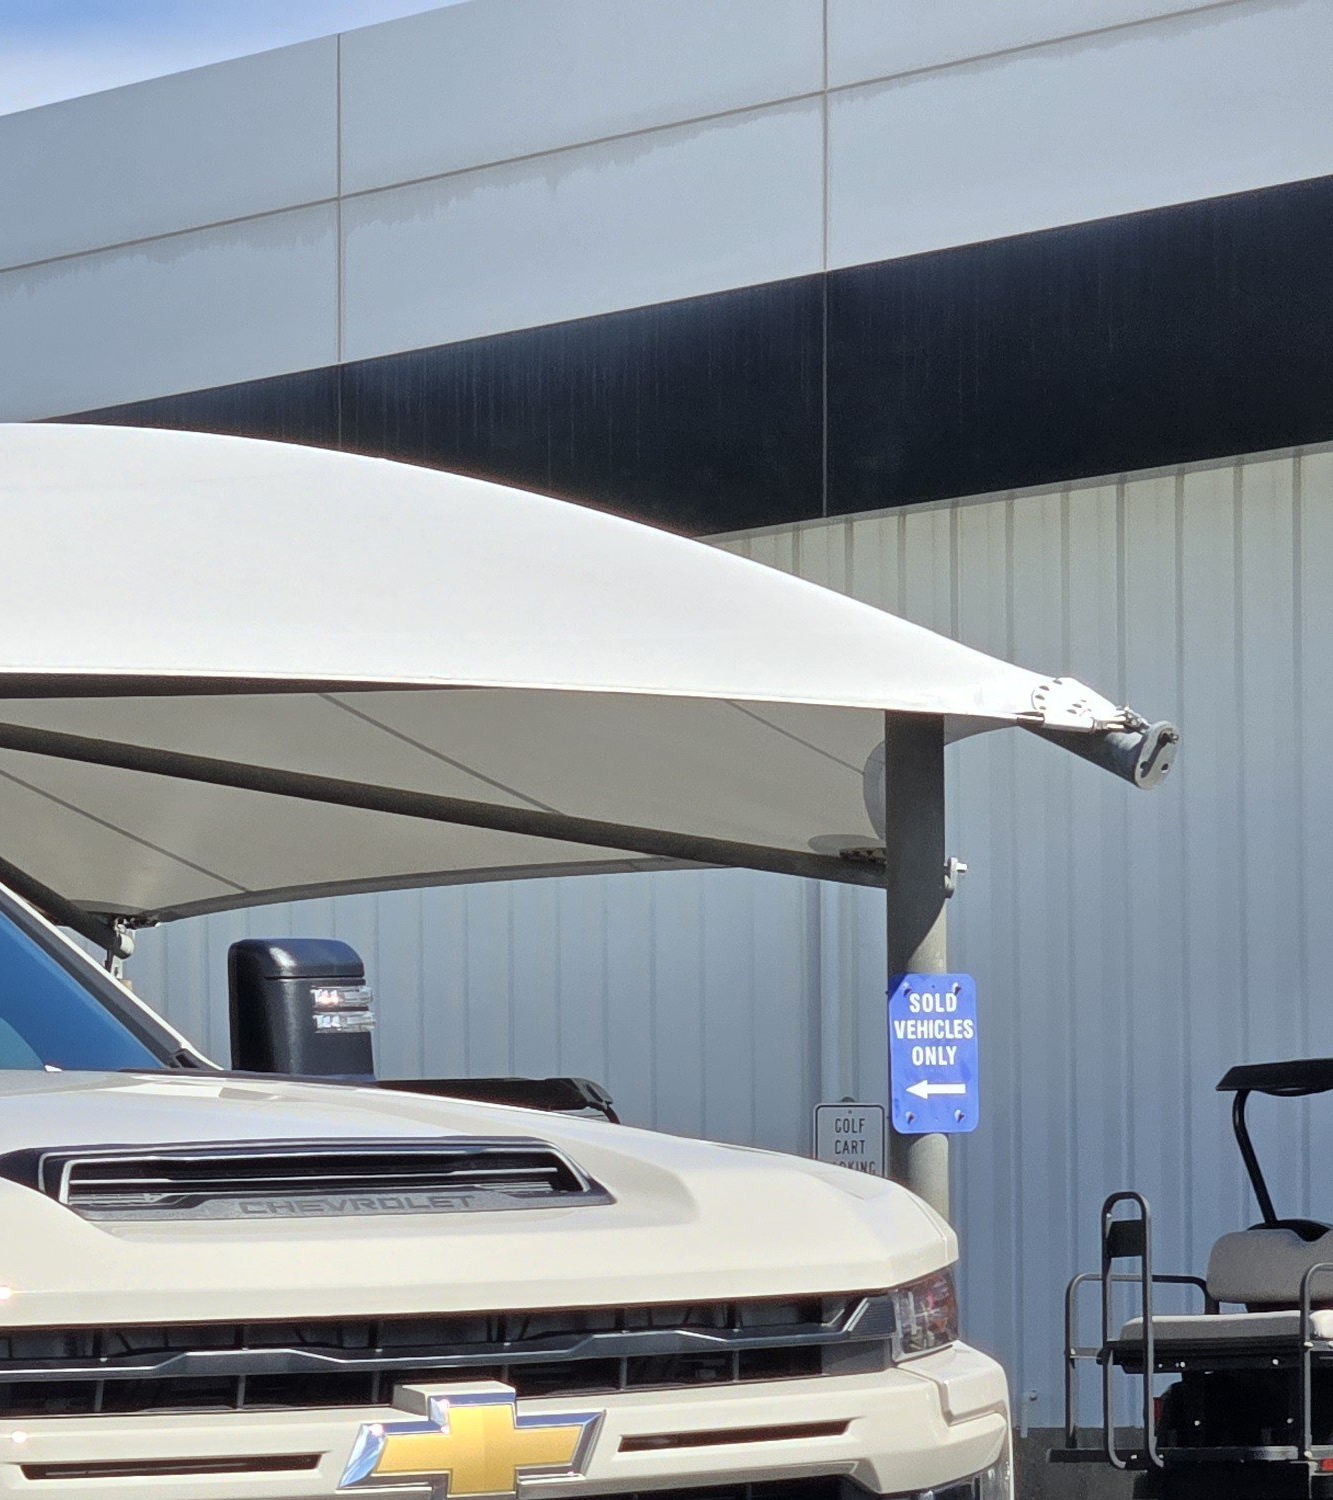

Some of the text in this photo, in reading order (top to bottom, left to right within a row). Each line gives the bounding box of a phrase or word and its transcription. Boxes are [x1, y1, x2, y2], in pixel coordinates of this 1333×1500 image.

[909, 993, 957, 1013] SOLD
[893, 1019, 975, 1040] VEHICLES
[911, 1045, 958, 1066] ONLY
[834, 1117, 866, 1134] GOLF
[834, 1139, 866, 1155] CART
[237, 1194, 476, 1215] CHEVROLET
